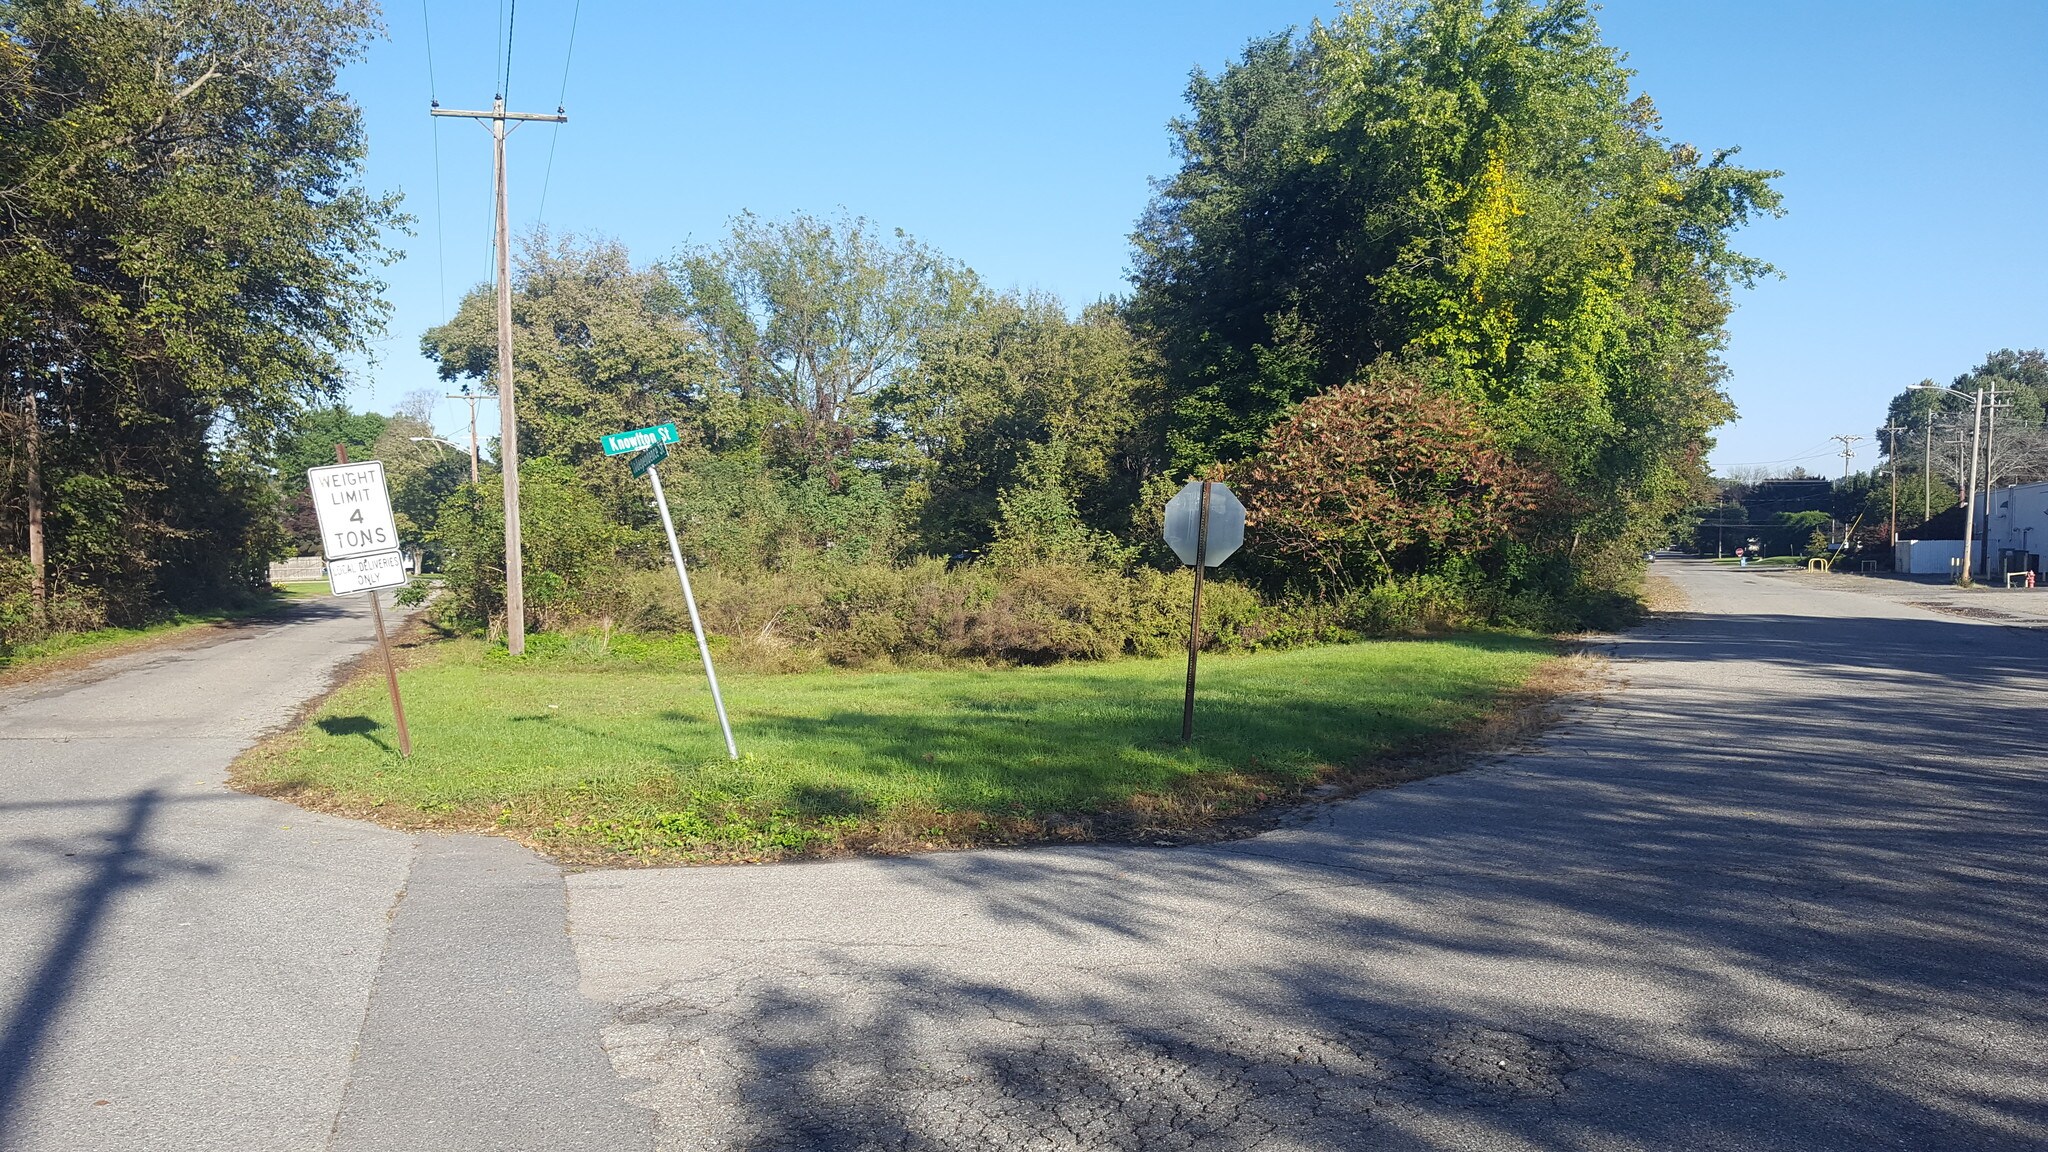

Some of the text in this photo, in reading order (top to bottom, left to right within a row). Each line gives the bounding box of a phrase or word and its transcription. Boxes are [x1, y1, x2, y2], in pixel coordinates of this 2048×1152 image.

[608, 426, 672, 452] Knowlton St
[318, 470, 375, 488] WEIGHT
[331, 488, 370, 505] LIMIT
[349, 508, 364, 524] 4
[334, 527, 387, 549] TONS
[358, 556, 400, 572] DELIVERIES
[357, 572, 380, 586] ONLY
